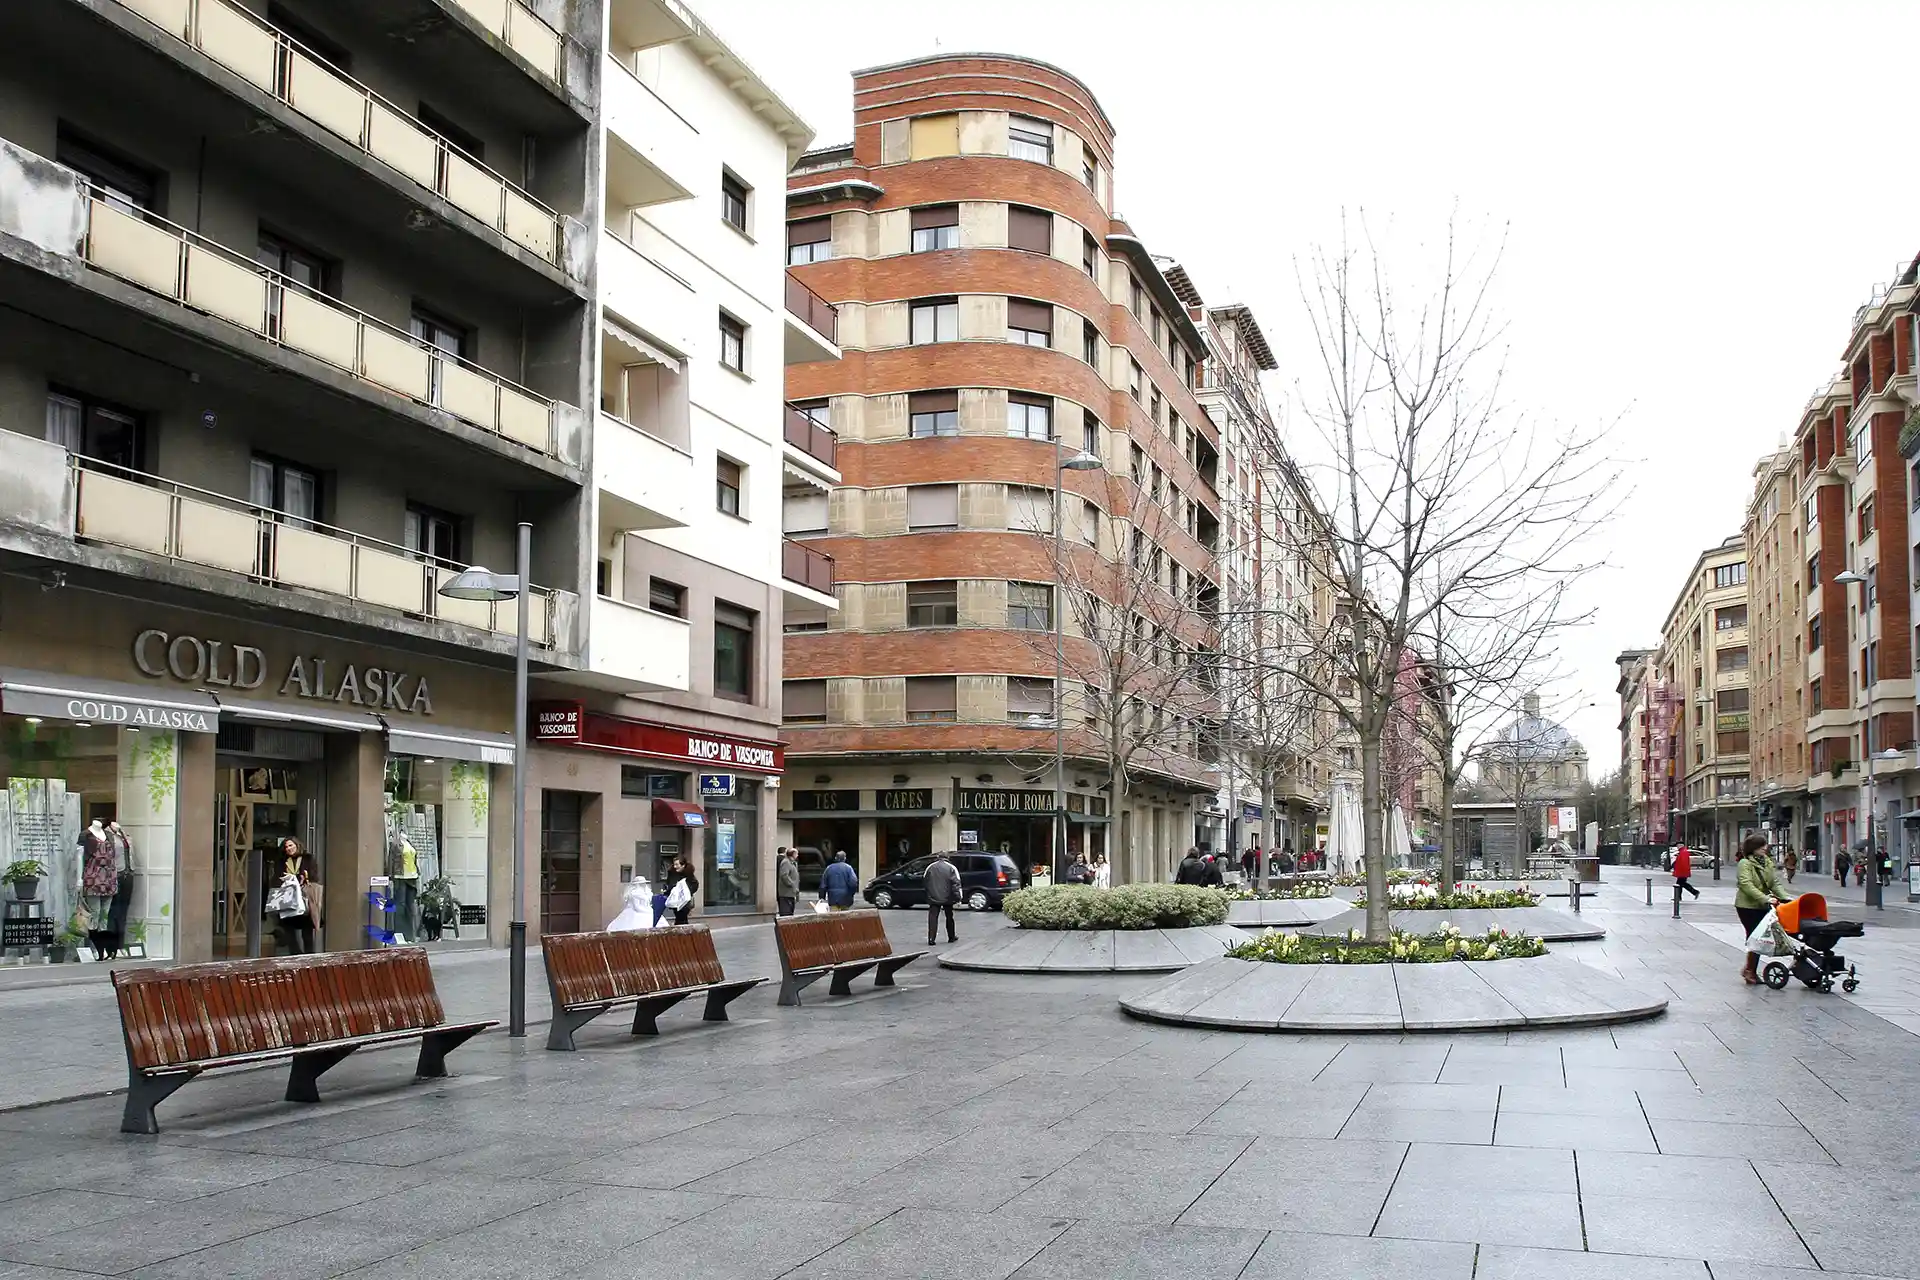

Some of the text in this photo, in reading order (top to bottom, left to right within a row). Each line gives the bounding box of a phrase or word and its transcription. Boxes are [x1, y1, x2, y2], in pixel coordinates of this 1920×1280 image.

[133, 629, 435, 715] COLD ALASKA
[67, 700, 209, 731] COLD ALASKA
[540, 712, 578, 722] BANCO DE
[540, 724, 577, 734] VASCONIA
[688, 738, 775, 767] BANCO DE VASCONIA
[960, 792, 970, 809] IL
[974, 792, 1006, 810] CAFFE
[1010, 792, 1020, 810] DI
[1024, 793, 1053, 811] ROMA
